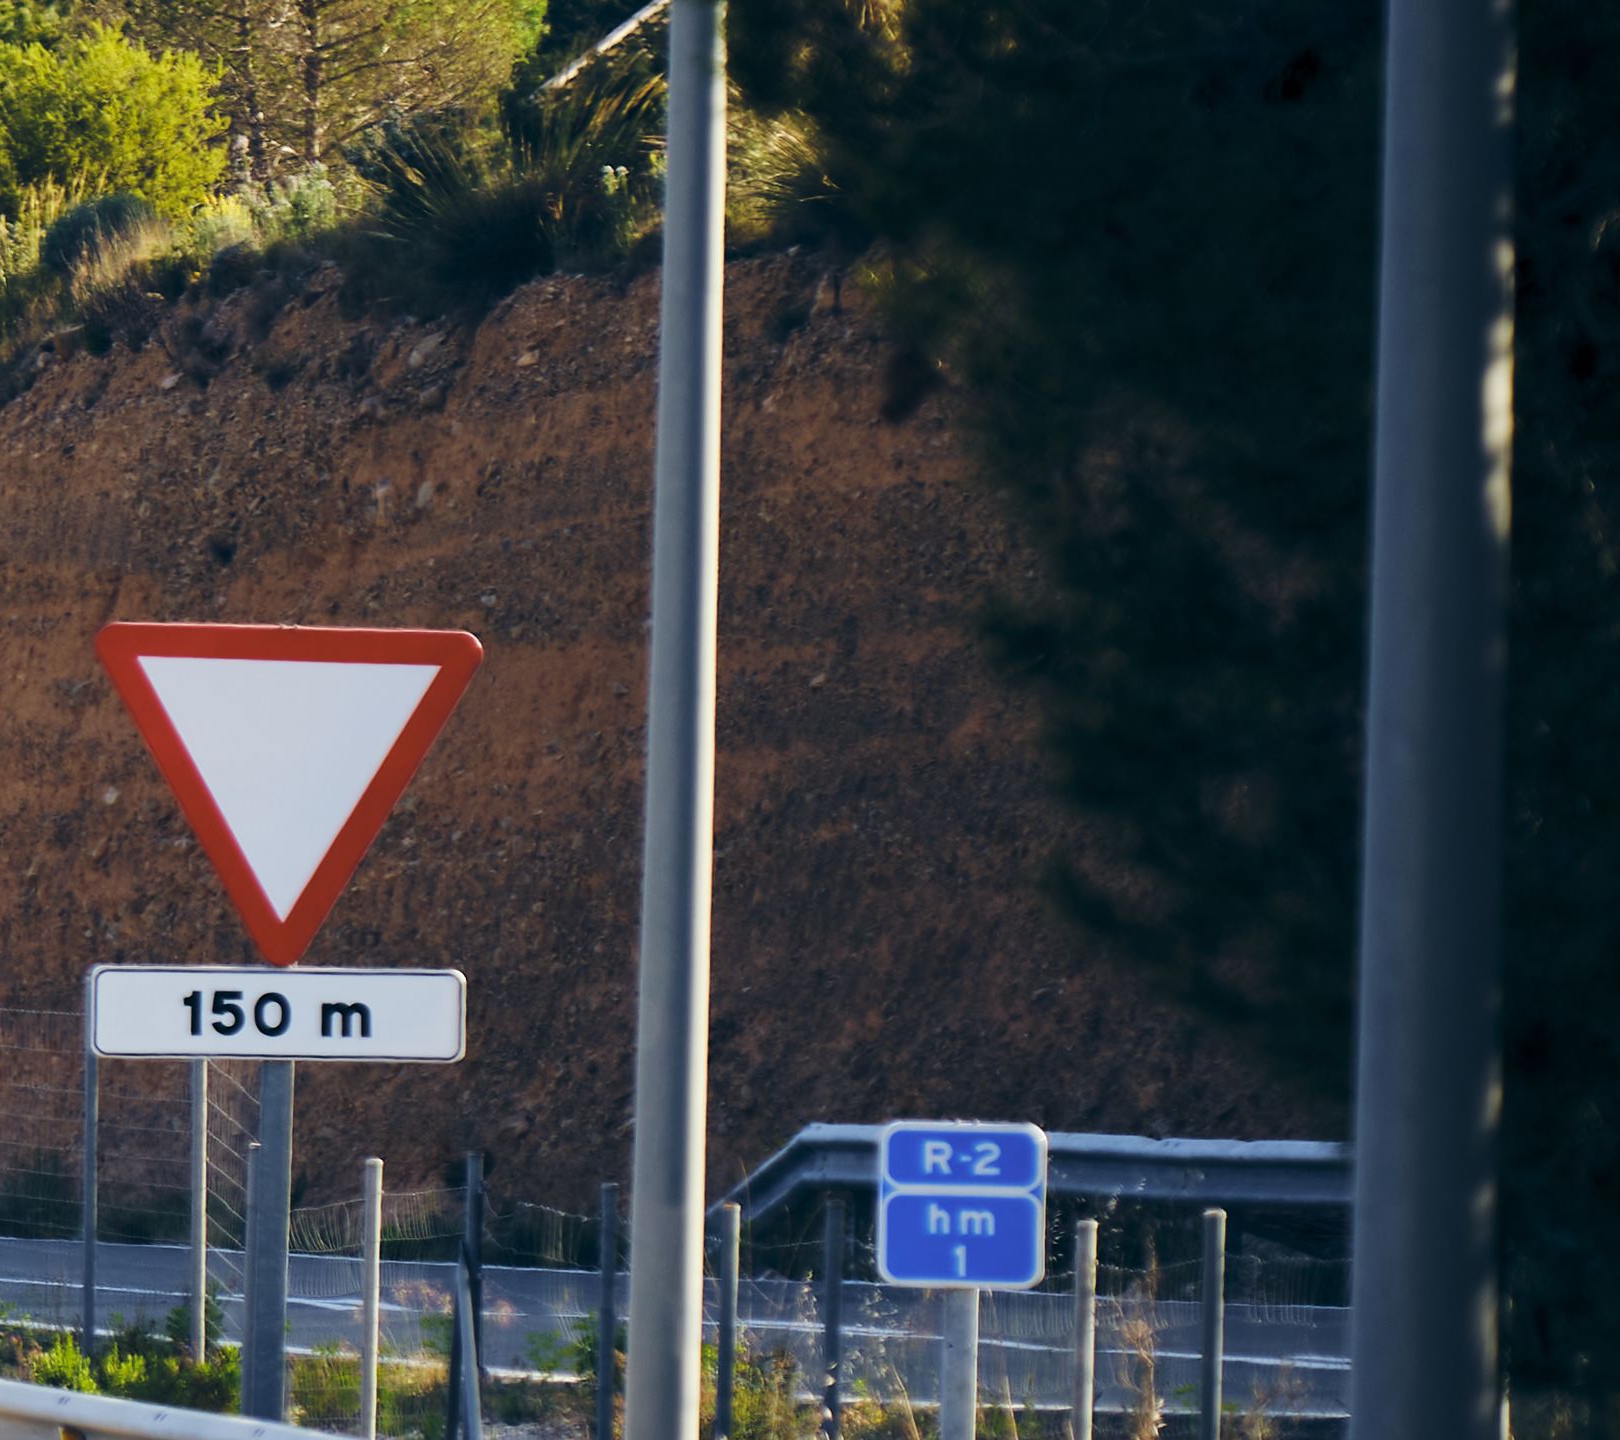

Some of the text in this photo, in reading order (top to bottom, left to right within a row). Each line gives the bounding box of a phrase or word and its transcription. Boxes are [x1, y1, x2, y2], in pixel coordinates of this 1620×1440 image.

[183, 990, 372, 1038] 150 m
[924, 1141, 1001, 1175] R-2
[954, 1245, 967, 1277] 1
